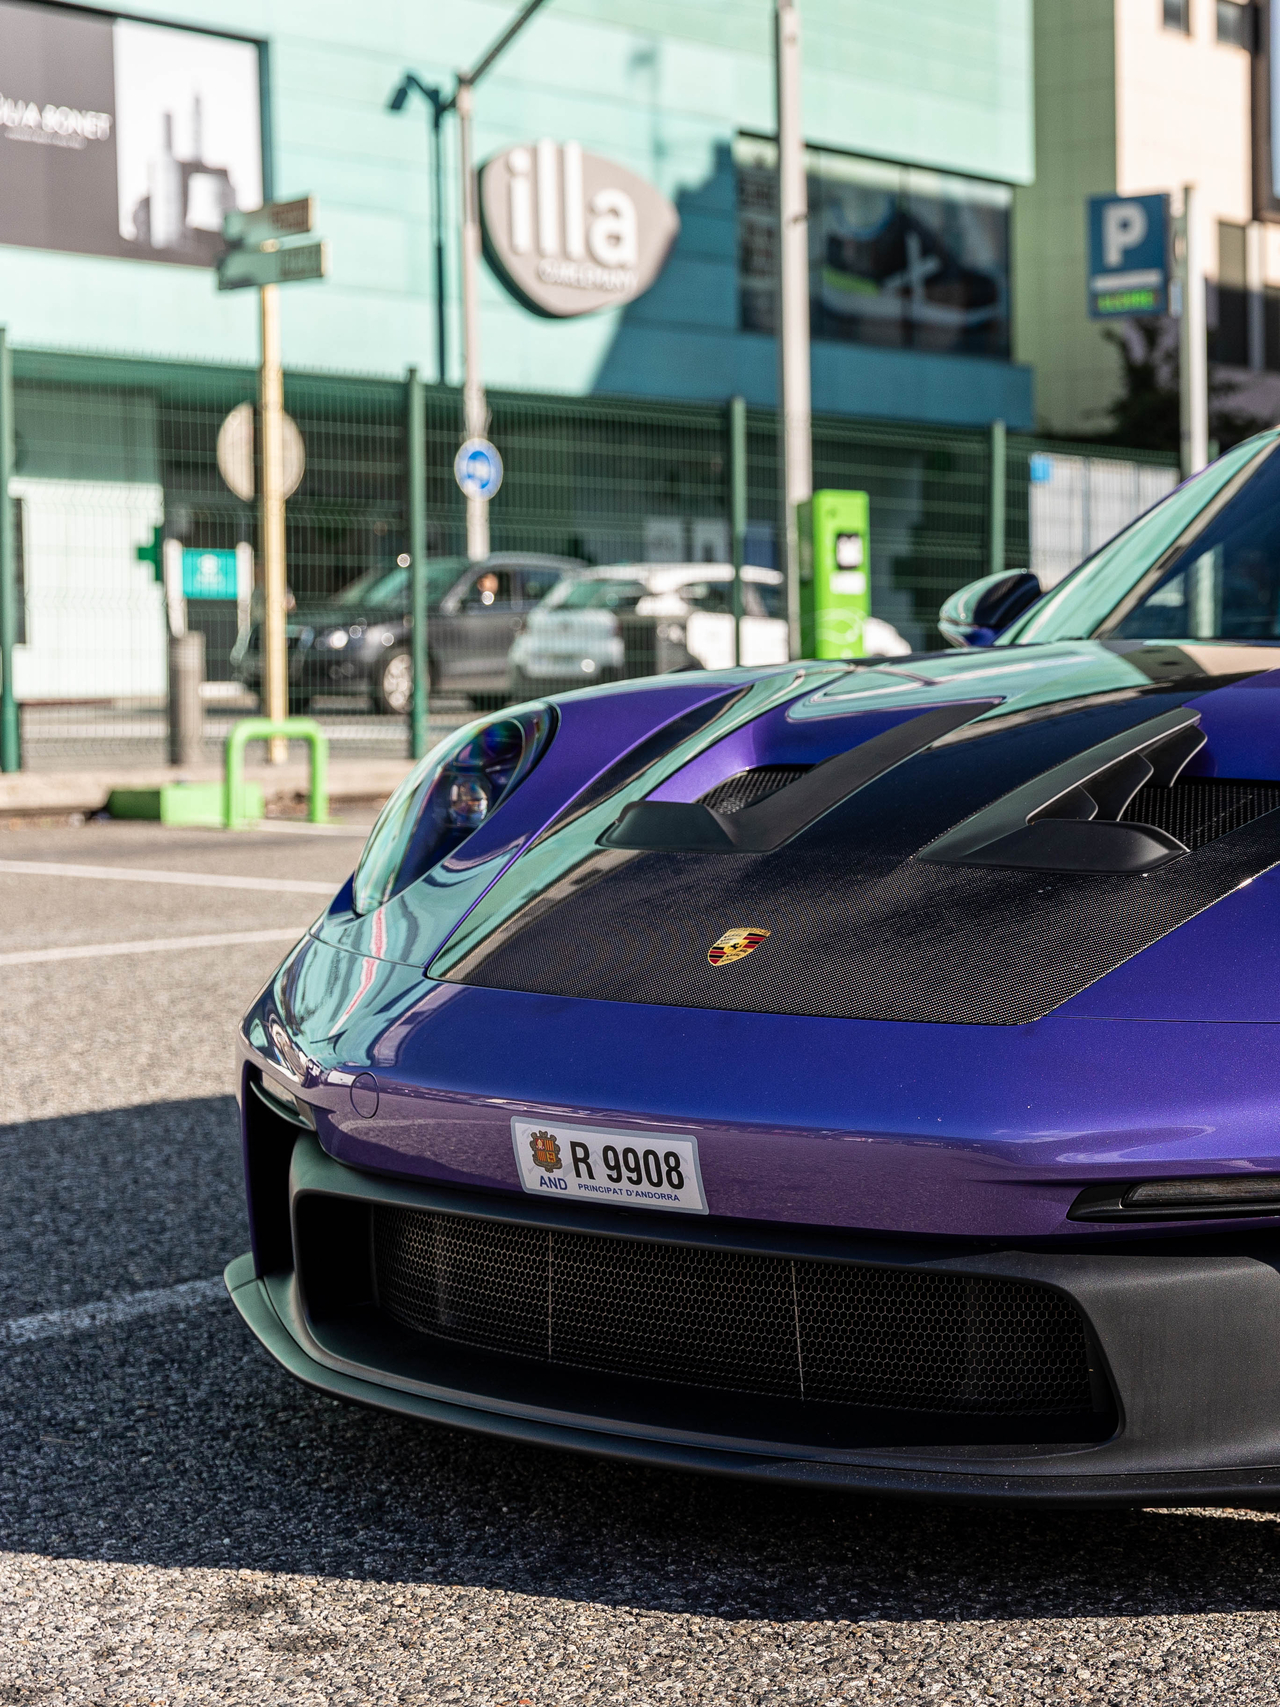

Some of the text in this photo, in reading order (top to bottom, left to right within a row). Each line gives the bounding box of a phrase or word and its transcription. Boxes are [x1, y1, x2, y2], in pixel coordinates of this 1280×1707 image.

[507, 136, 639, 270] illa
[1102, 200, 1148, 268] P
[539, 1175, 568, 1191] AND
[569, 1140, 685, 1190] R 9908
[577, 1183, 681, 1202] PRINCIPAT D'ANDORRA
